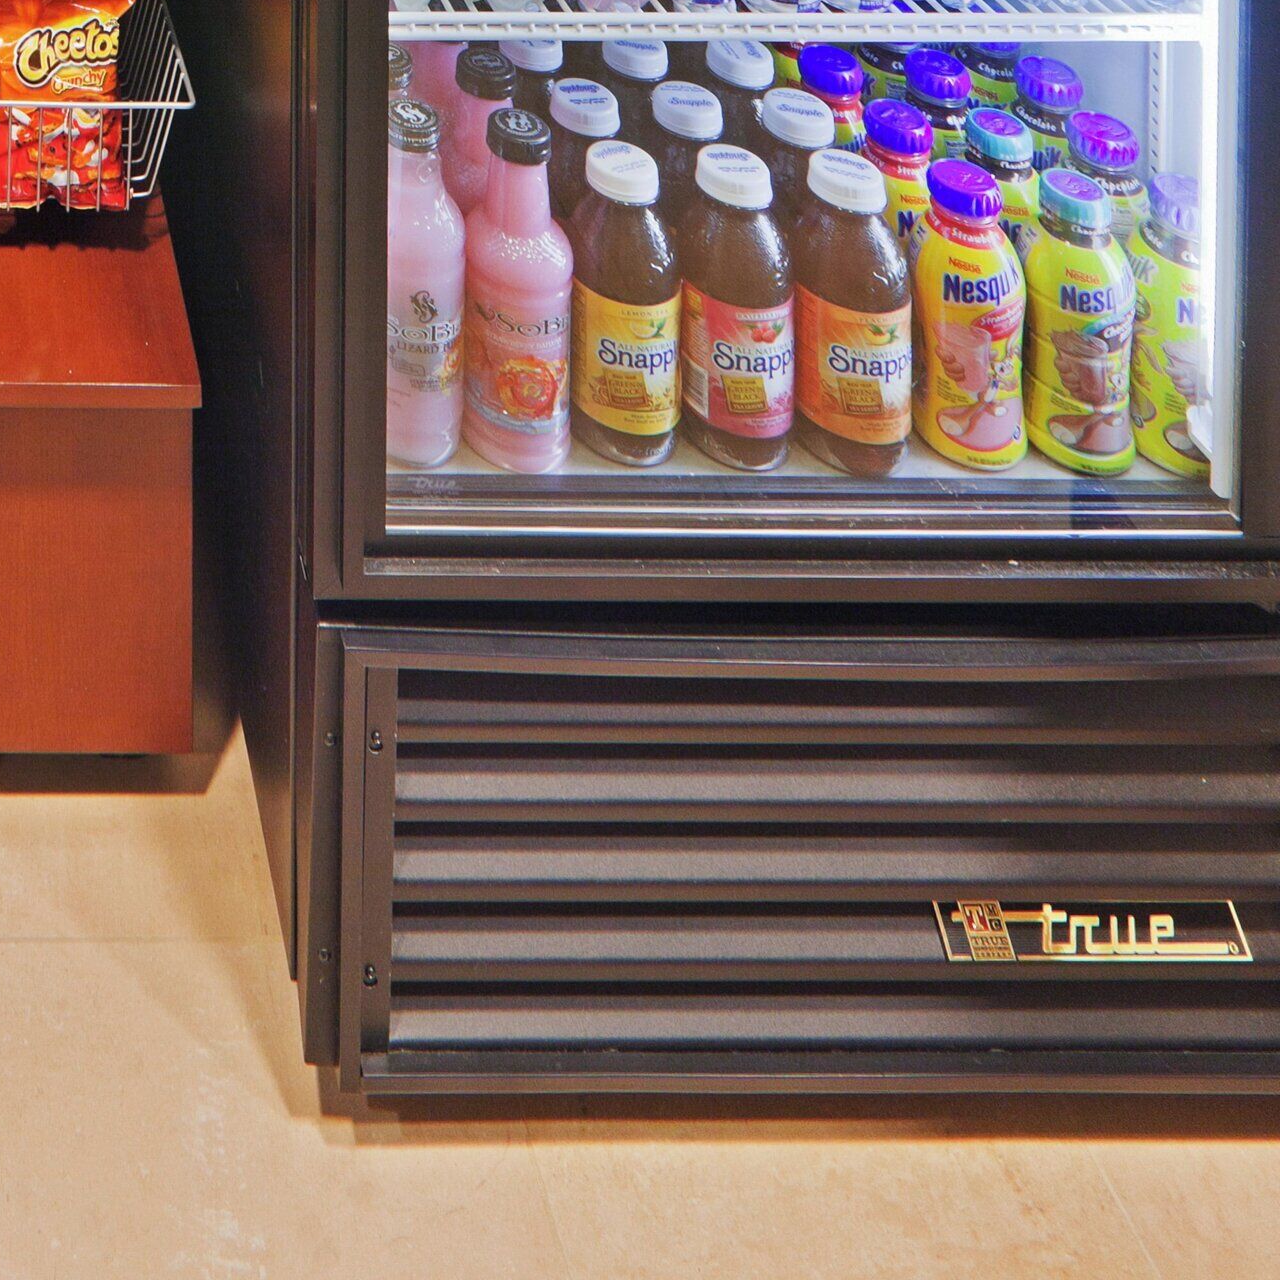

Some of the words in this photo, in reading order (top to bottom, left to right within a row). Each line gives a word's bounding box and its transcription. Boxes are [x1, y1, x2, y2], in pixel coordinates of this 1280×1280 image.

[17, 19, 118, 87] Cheetos
[52, 68, 105, 95] Crunchy
[668, 95, 713, 108] Snapple
[951, 902, 1229, 955] true
[971, 935, 1009, 945] TRUE
